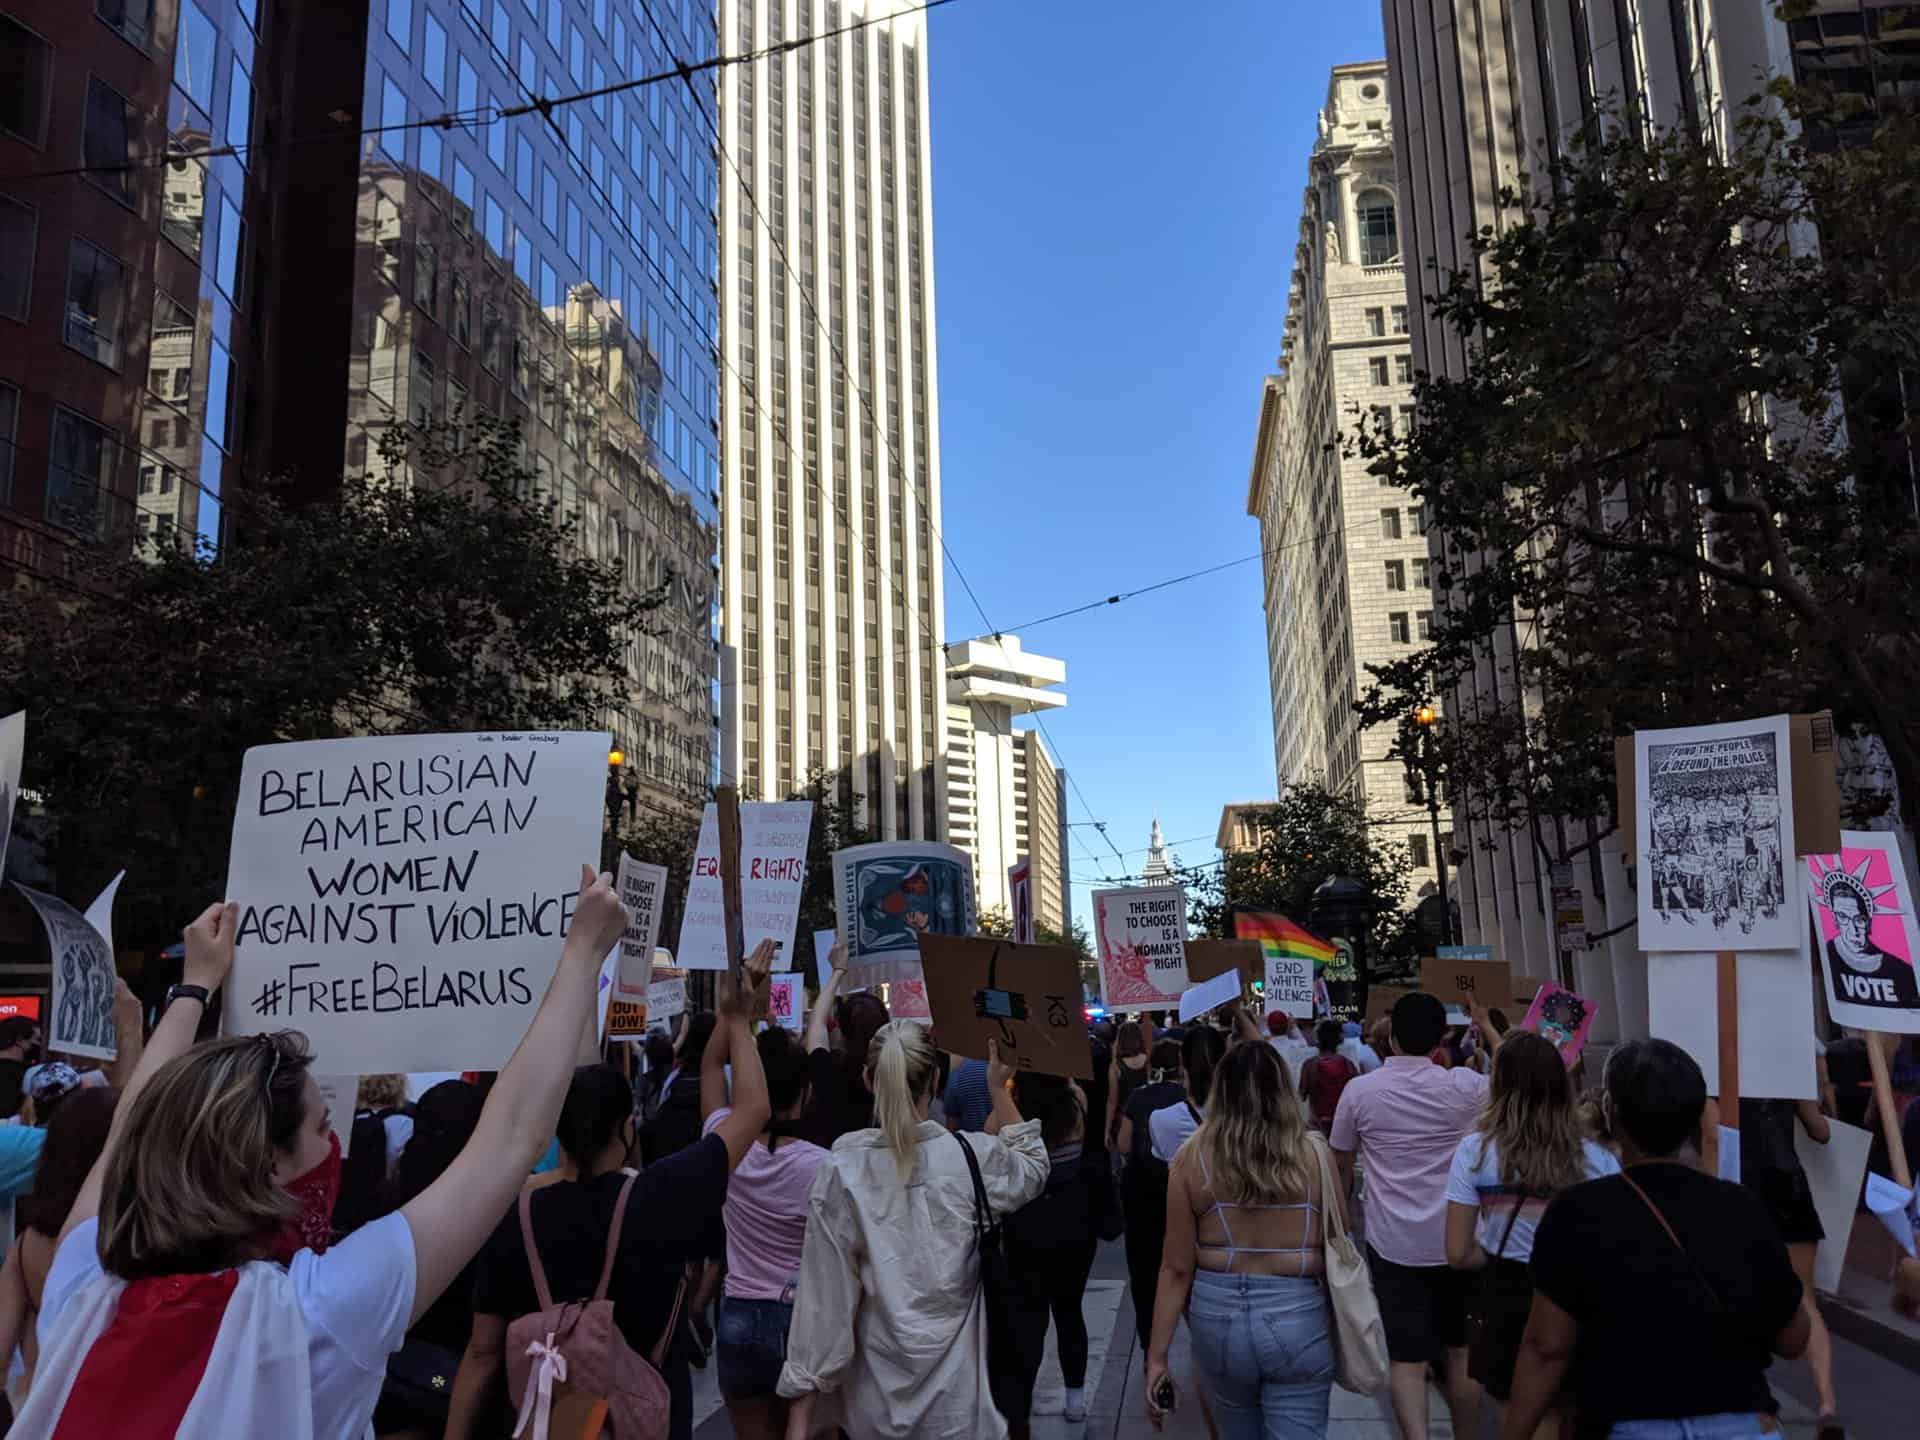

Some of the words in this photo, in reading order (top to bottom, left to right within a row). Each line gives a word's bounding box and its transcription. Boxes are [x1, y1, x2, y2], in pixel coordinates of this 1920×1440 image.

[1699, 744, 1715, 754] THE
[1717, 739, 1751, 751] PEOPLE
[1671, 757, 1712, 770] DEFUND
[1713, 755, 1729, 767] THE
[1732, 750, 1766, 765] POLICE
[307, 850, 479, 898] WOMEN
[750, 857, 803, 882] RIGHTS
[632, 878, 656, 894] RIGHT
[1128, 902, 1148, 914] THE
[1148, 900, 1177, 912] RIGHT
[235, 902, 415, 945] AGAINST
[635, 912, 643, 925] IS
[644, 913, 650, 927] A
[1126, 917, 1138, 928] TO
[1140, 915, 1177, 928] CHOOSE
[1162, 930, 1171, 940] IS
[1172, 928, 1179, 940] A
[1134, 942, 1180, 956] WOMAN'S
[1154, 957, 1182, 969] RIGHT
[1275, 962, 1304, 974] END
[1270, 975, 1308, 988] WHITE
[1841, 973, 1899, 1002] VOTE
[1267, 988, 1313, 1002] SILENCE
[613, 1001, 640, 1014] OUT
